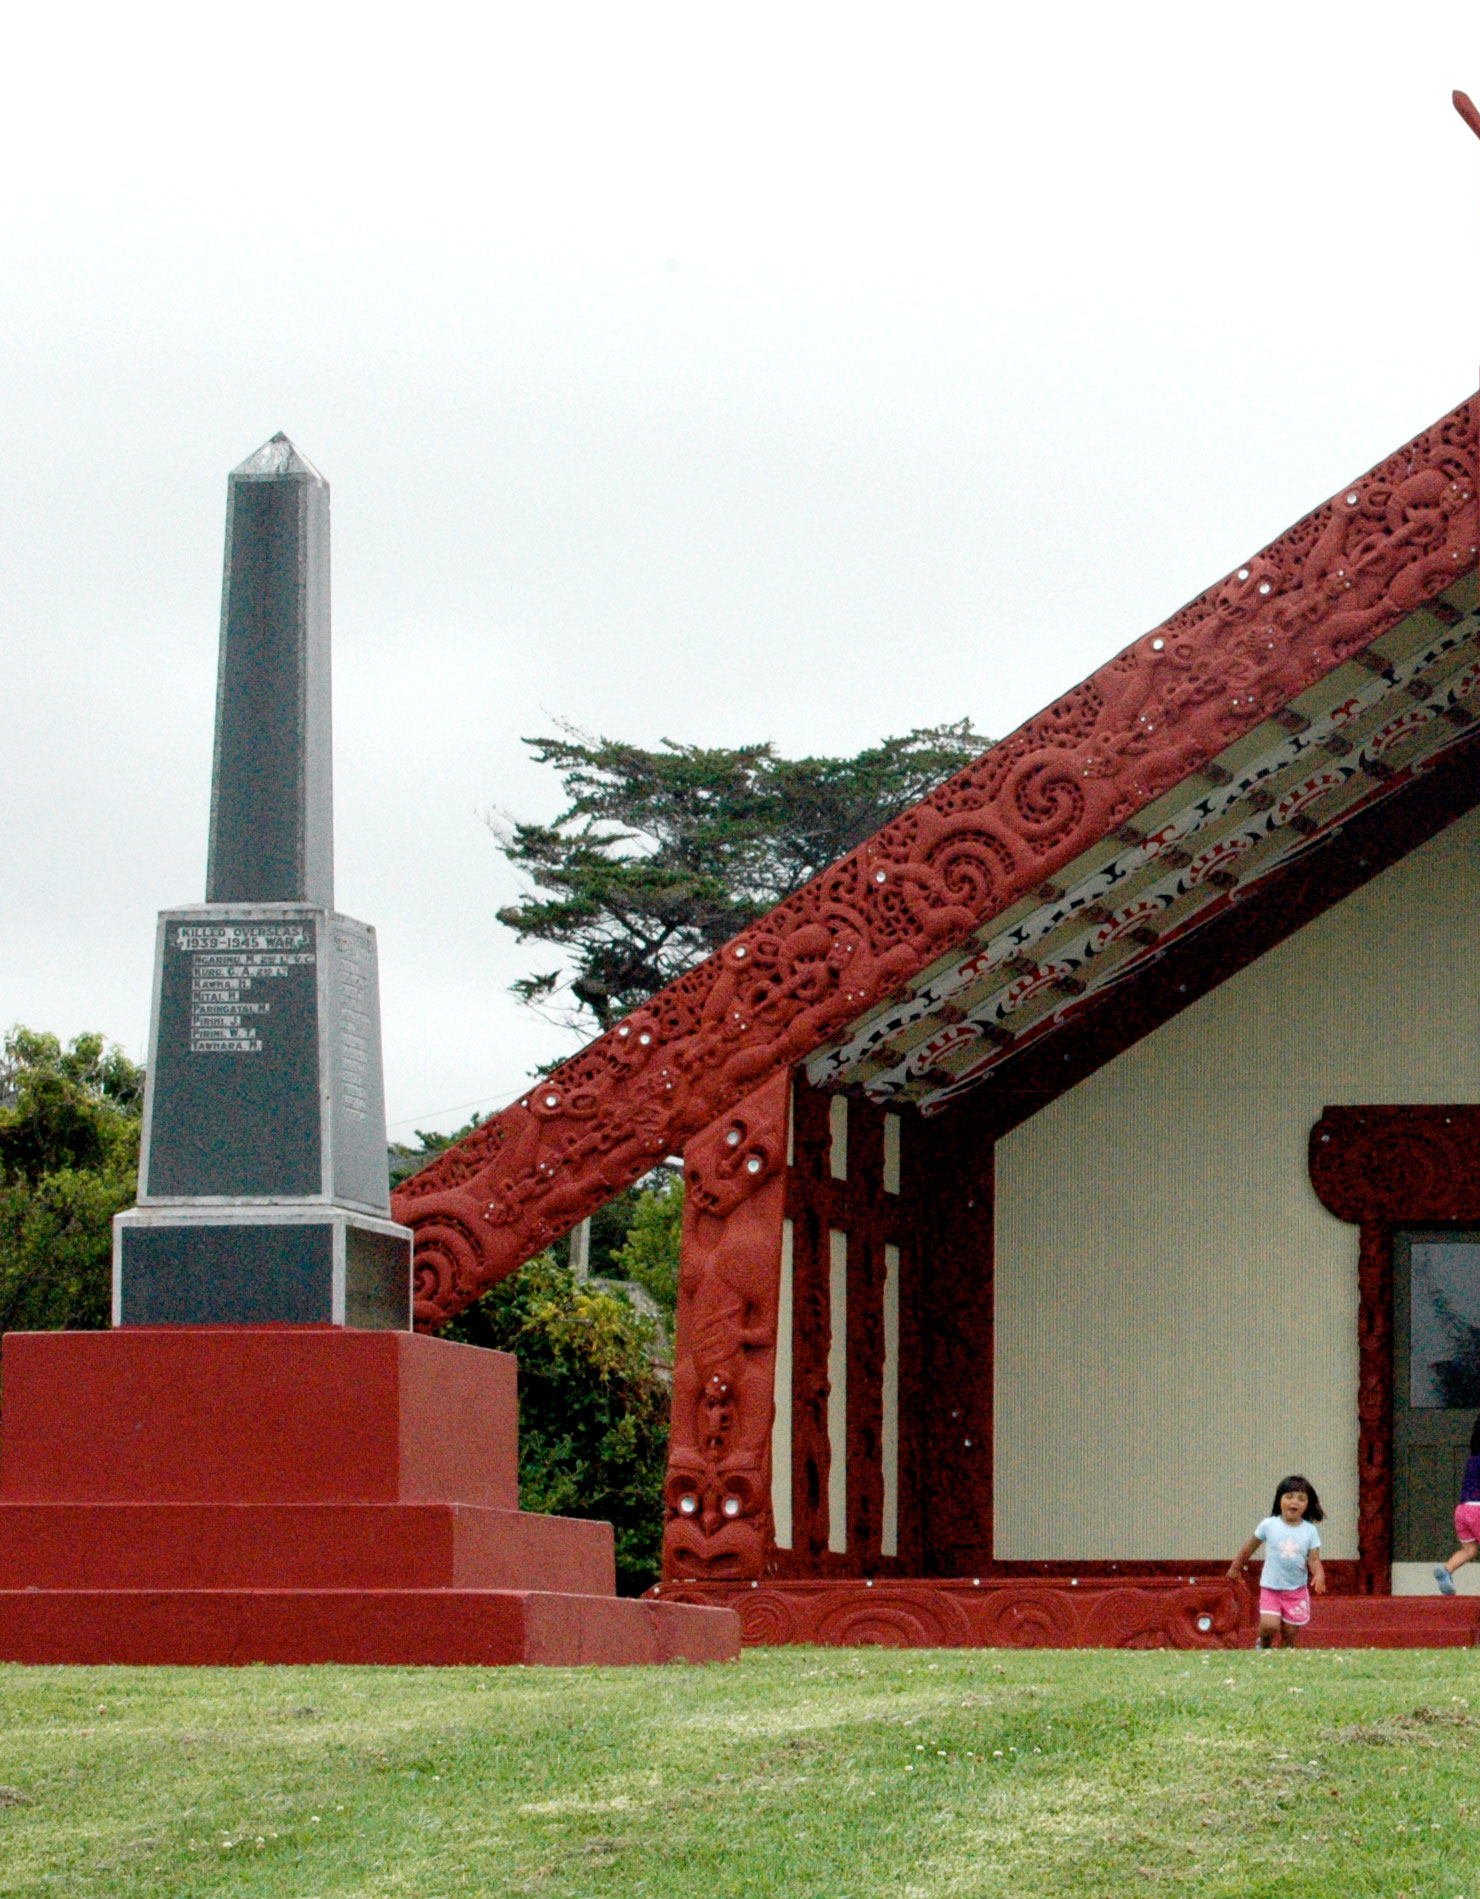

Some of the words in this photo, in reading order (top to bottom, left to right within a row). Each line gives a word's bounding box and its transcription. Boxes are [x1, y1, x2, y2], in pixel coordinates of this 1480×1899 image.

[182, 928, 226, 937] KILLED
[233, 928, 301, 937] OVERSEAS
[186, 938, 259, 948] 1939-1945
